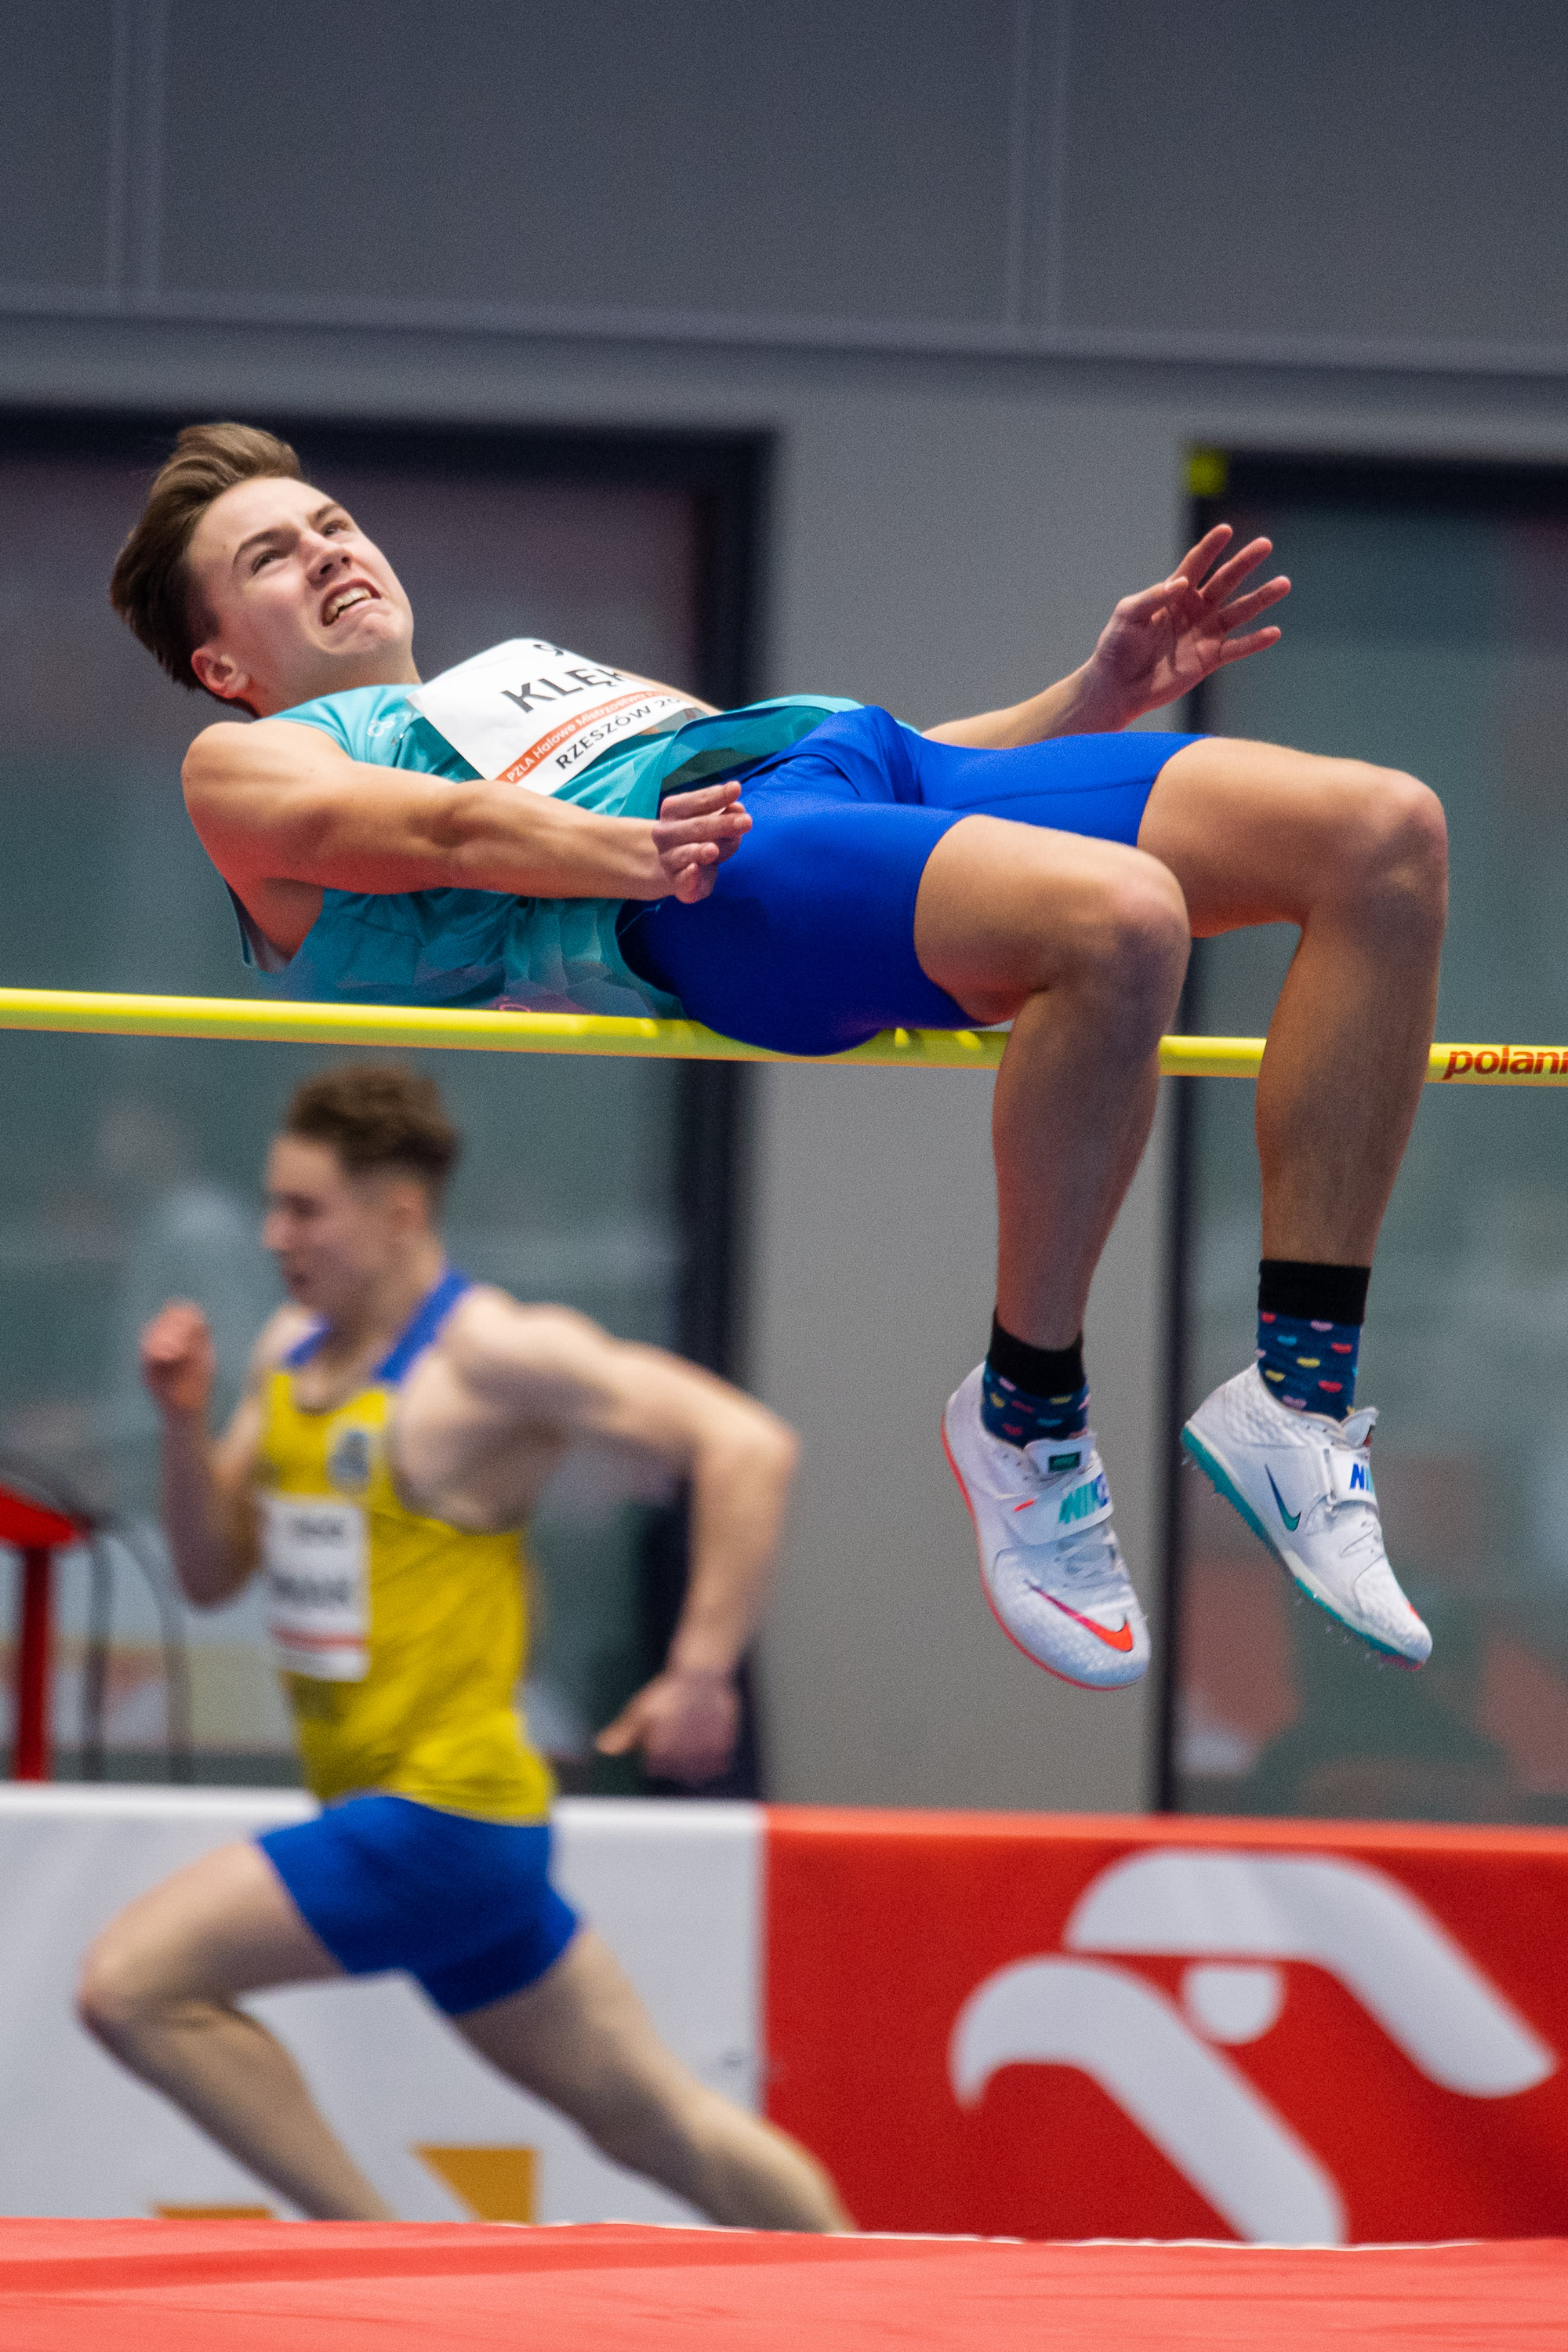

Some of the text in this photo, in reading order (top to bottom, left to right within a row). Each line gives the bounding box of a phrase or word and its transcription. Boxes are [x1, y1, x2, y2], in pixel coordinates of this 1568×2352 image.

[506, 757, 535, 782] PZLA
[532, 724, 576, 759] Halowe
[555, 706, 652, 769] RZESZÓW
